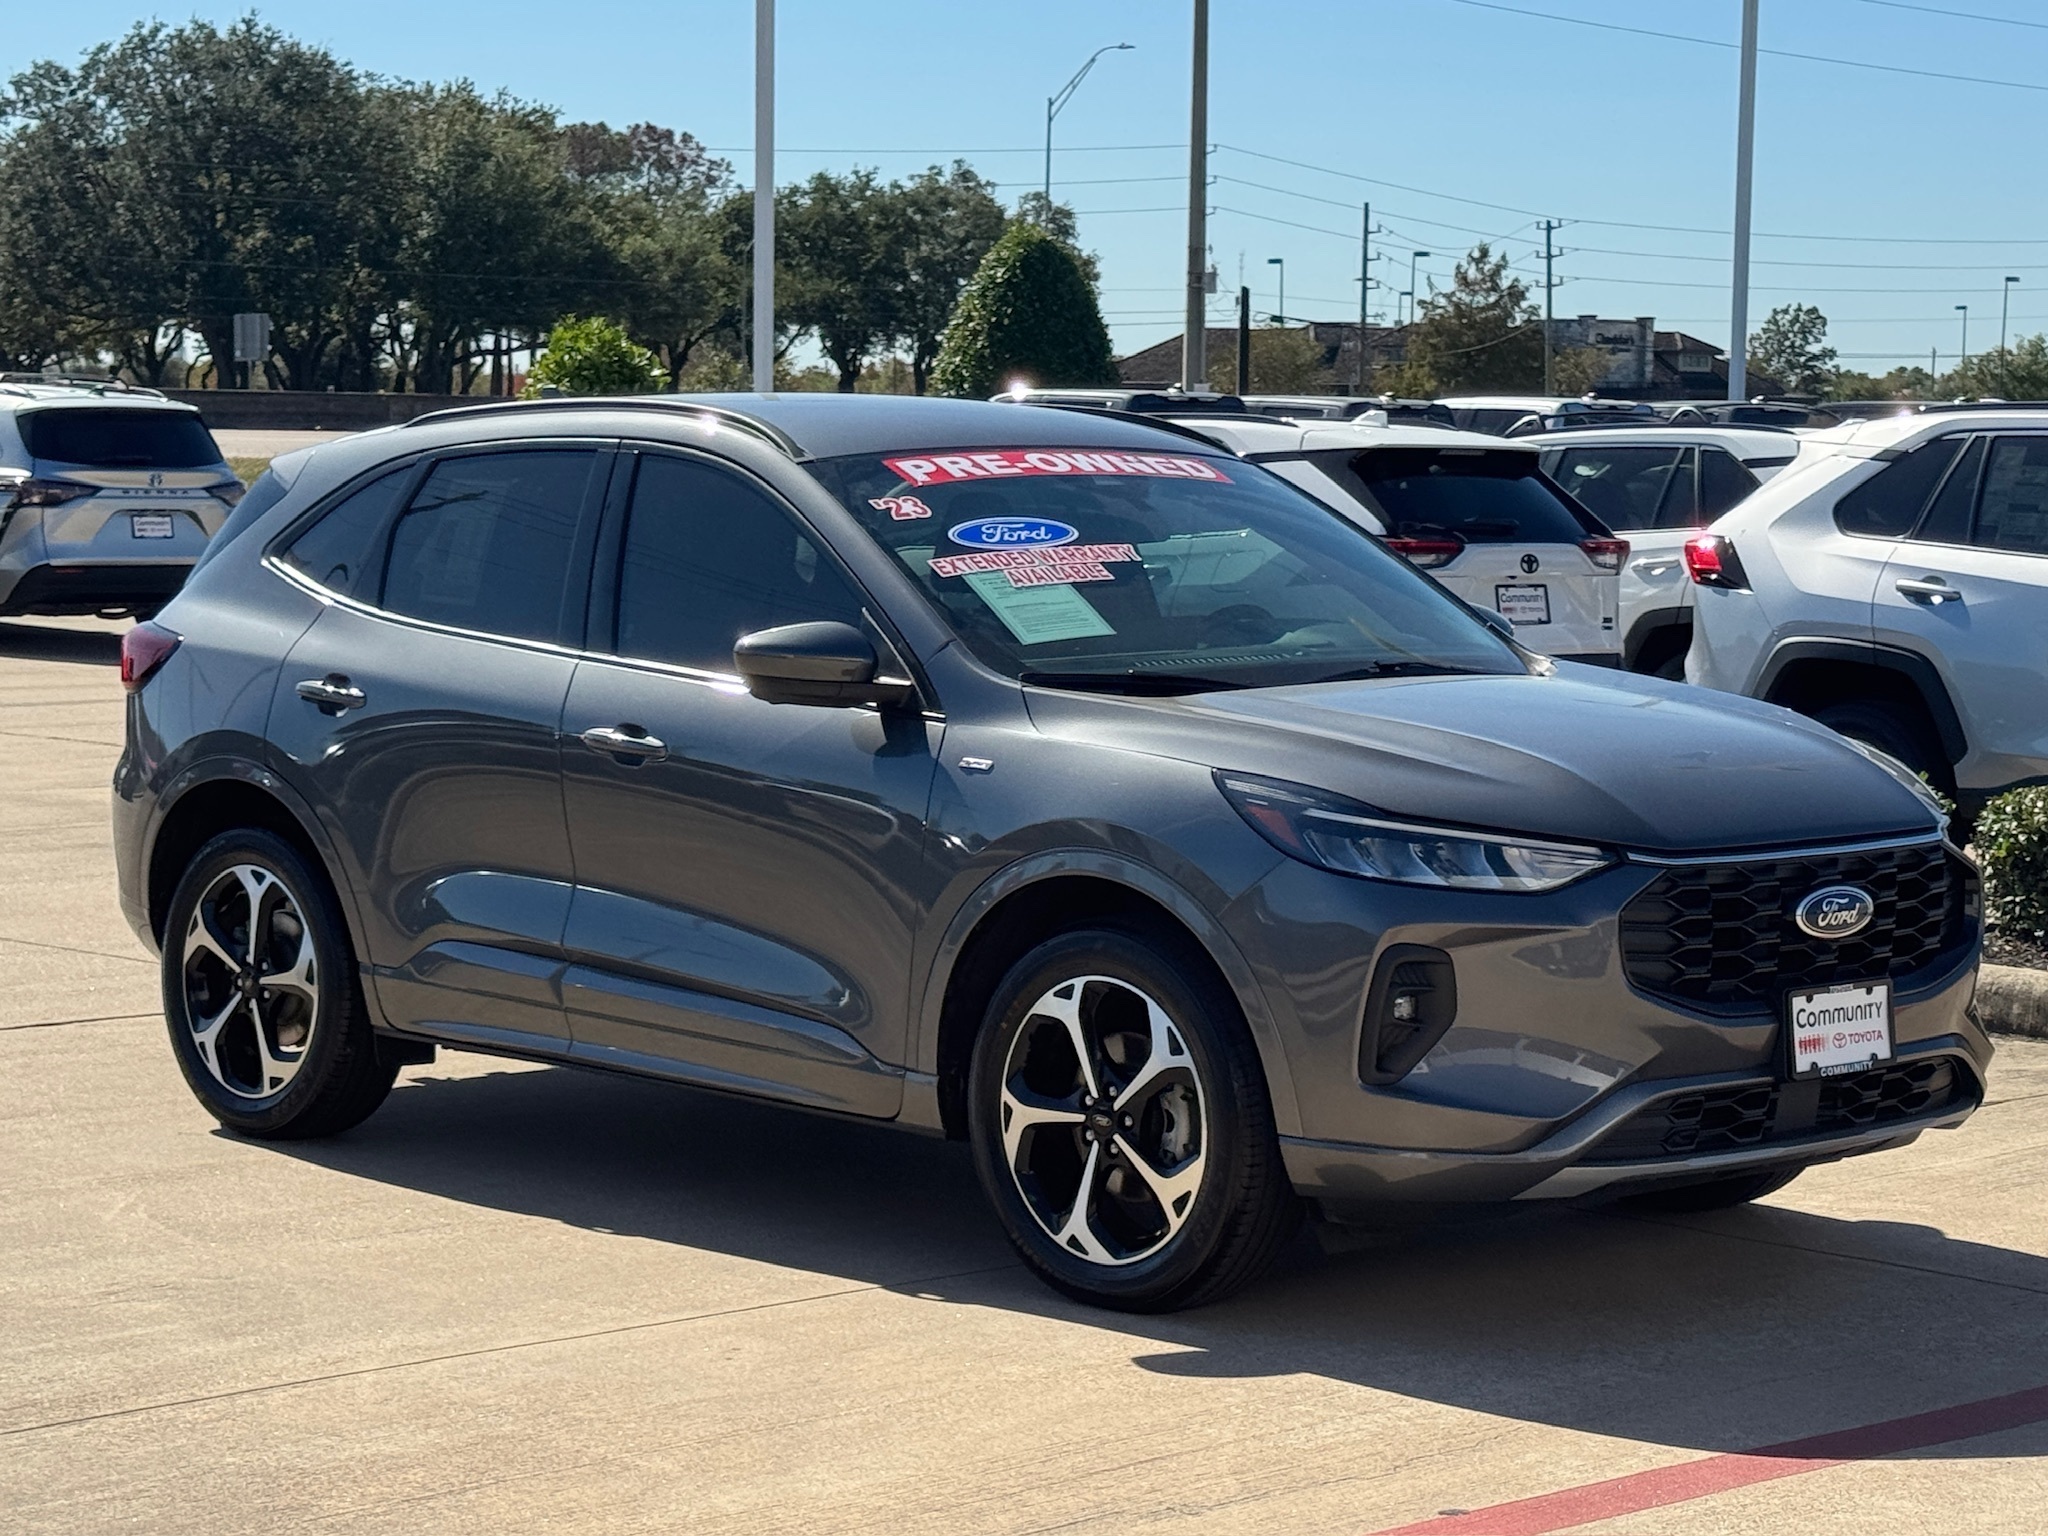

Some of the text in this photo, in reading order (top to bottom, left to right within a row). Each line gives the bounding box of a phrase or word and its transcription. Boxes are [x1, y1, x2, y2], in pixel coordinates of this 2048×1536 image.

[895, 452, 1218, 486] PRE-OWNED
[869, 496, 932, 520] '23
[981, 523, 1053, 543] Ford
[930, 545, 1140, 575] EXTENDED WARRANTY
[1006, 563, 1111, 586] AVAILABLE
[1817, 897, 1861, 927] Ford
[1847, 1030, 1884, 1046] TOYOTA
[1820, 1060, 1875, 1078] COMMUNITY
